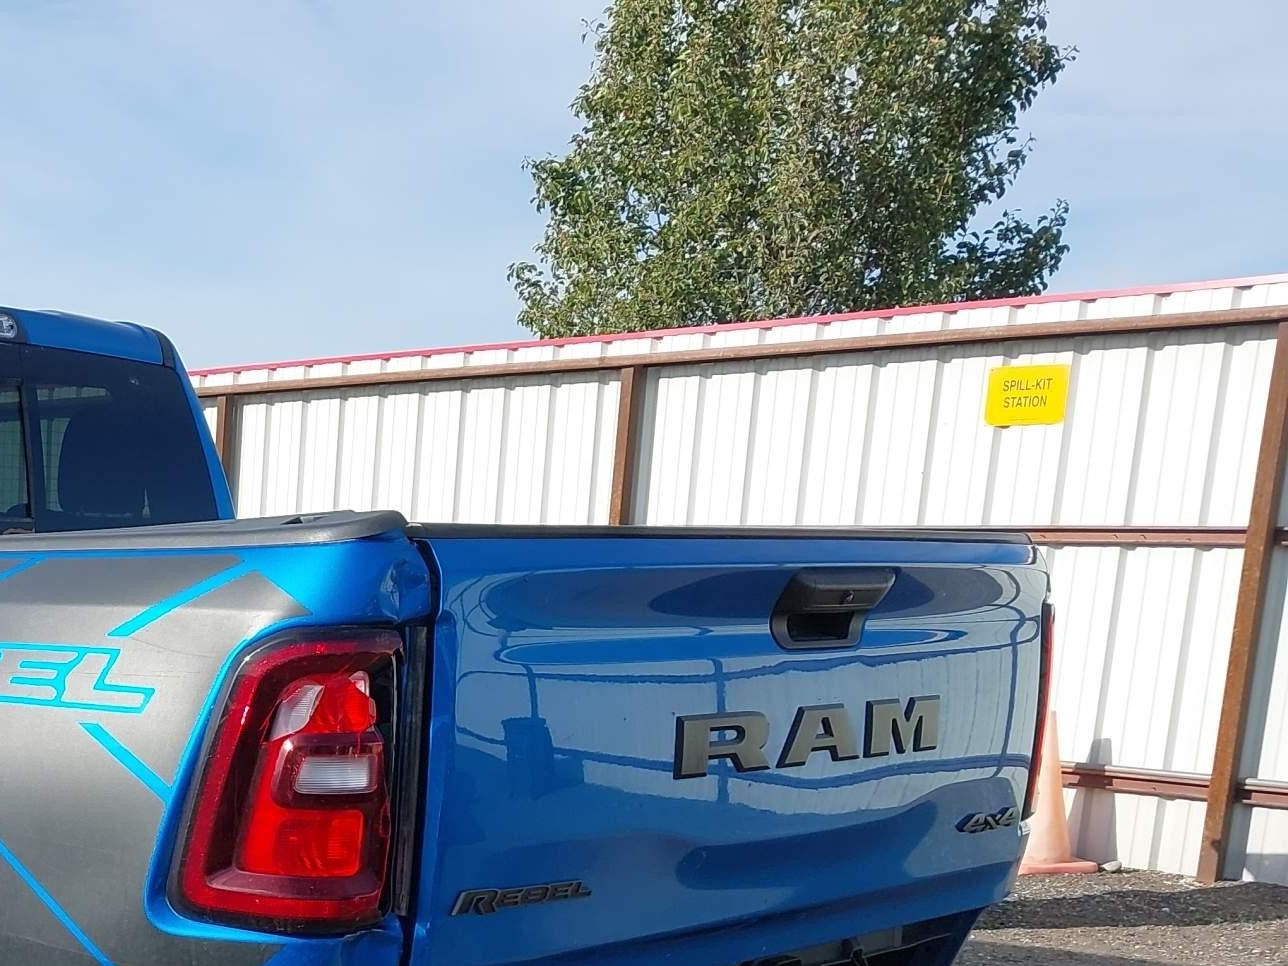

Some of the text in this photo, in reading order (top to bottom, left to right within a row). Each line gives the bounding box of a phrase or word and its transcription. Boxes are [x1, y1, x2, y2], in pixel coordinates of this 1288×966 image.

[1002, 377, 1054, 392] SPILL-KIT
[1002, 395, 1048, 409] STATION
[673, 695, 941, 780] RAM
[450, 878, 592, 917] REBEL
